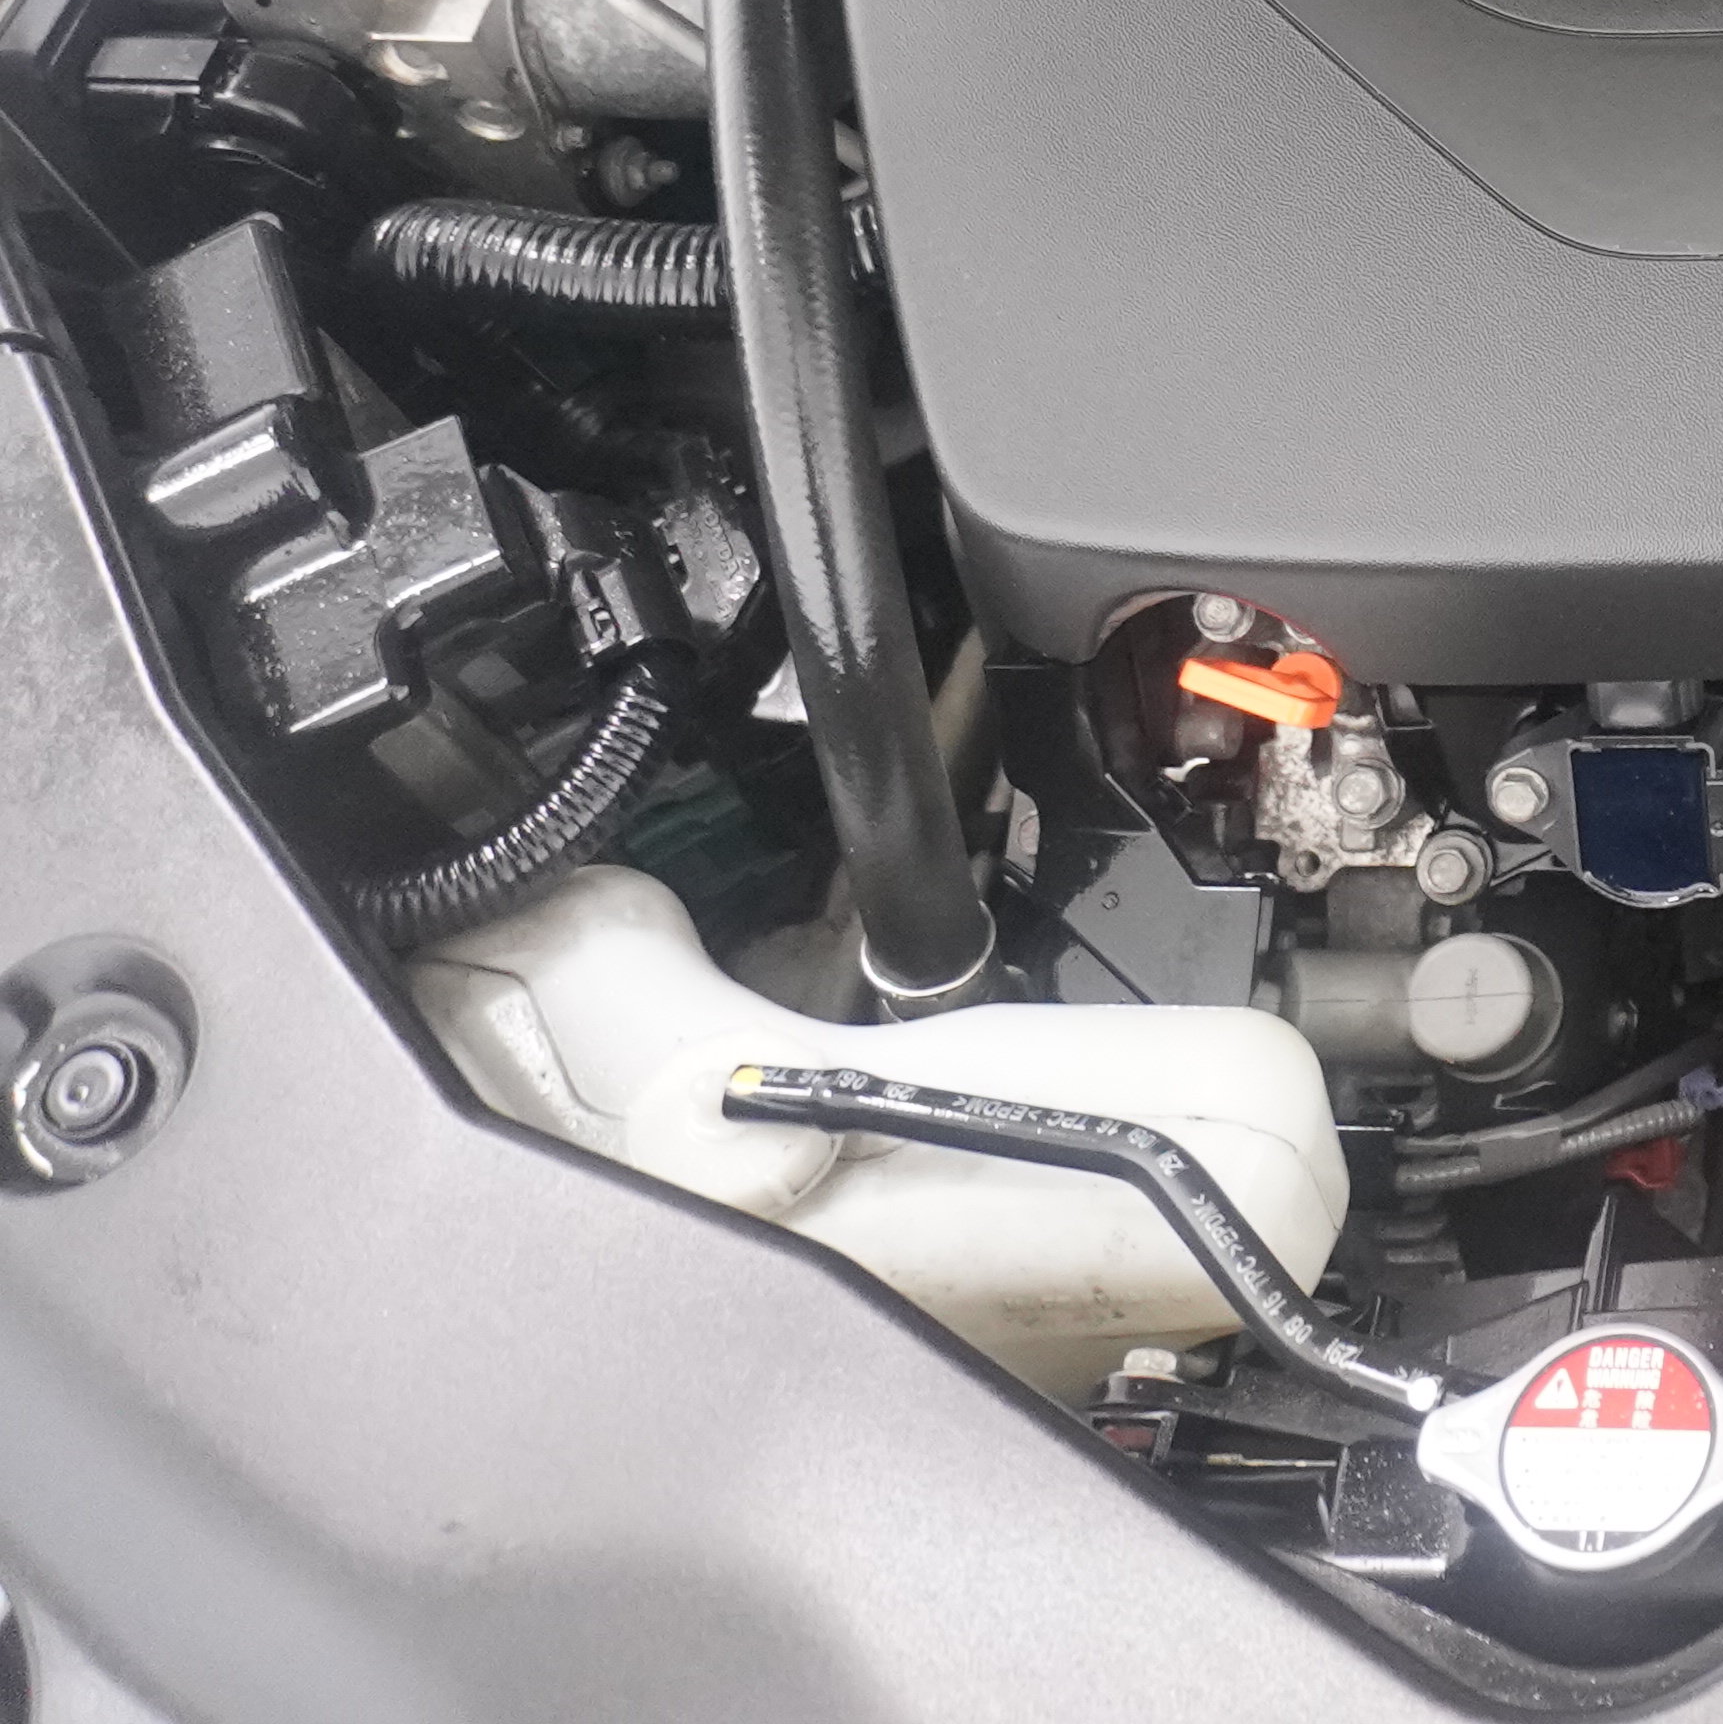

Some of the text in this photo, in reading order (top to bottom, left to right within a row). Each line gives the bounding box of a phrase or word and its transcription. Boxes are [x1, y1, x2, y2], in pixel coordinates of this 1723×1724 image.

[1046, 1110, 1090, 1132] TPC
[1236, 1255, 1272, 1296] TPC
[1588, 1346, 1665, 1370] DANGER
[1579, 1530, 1605, 1551] 1.1
